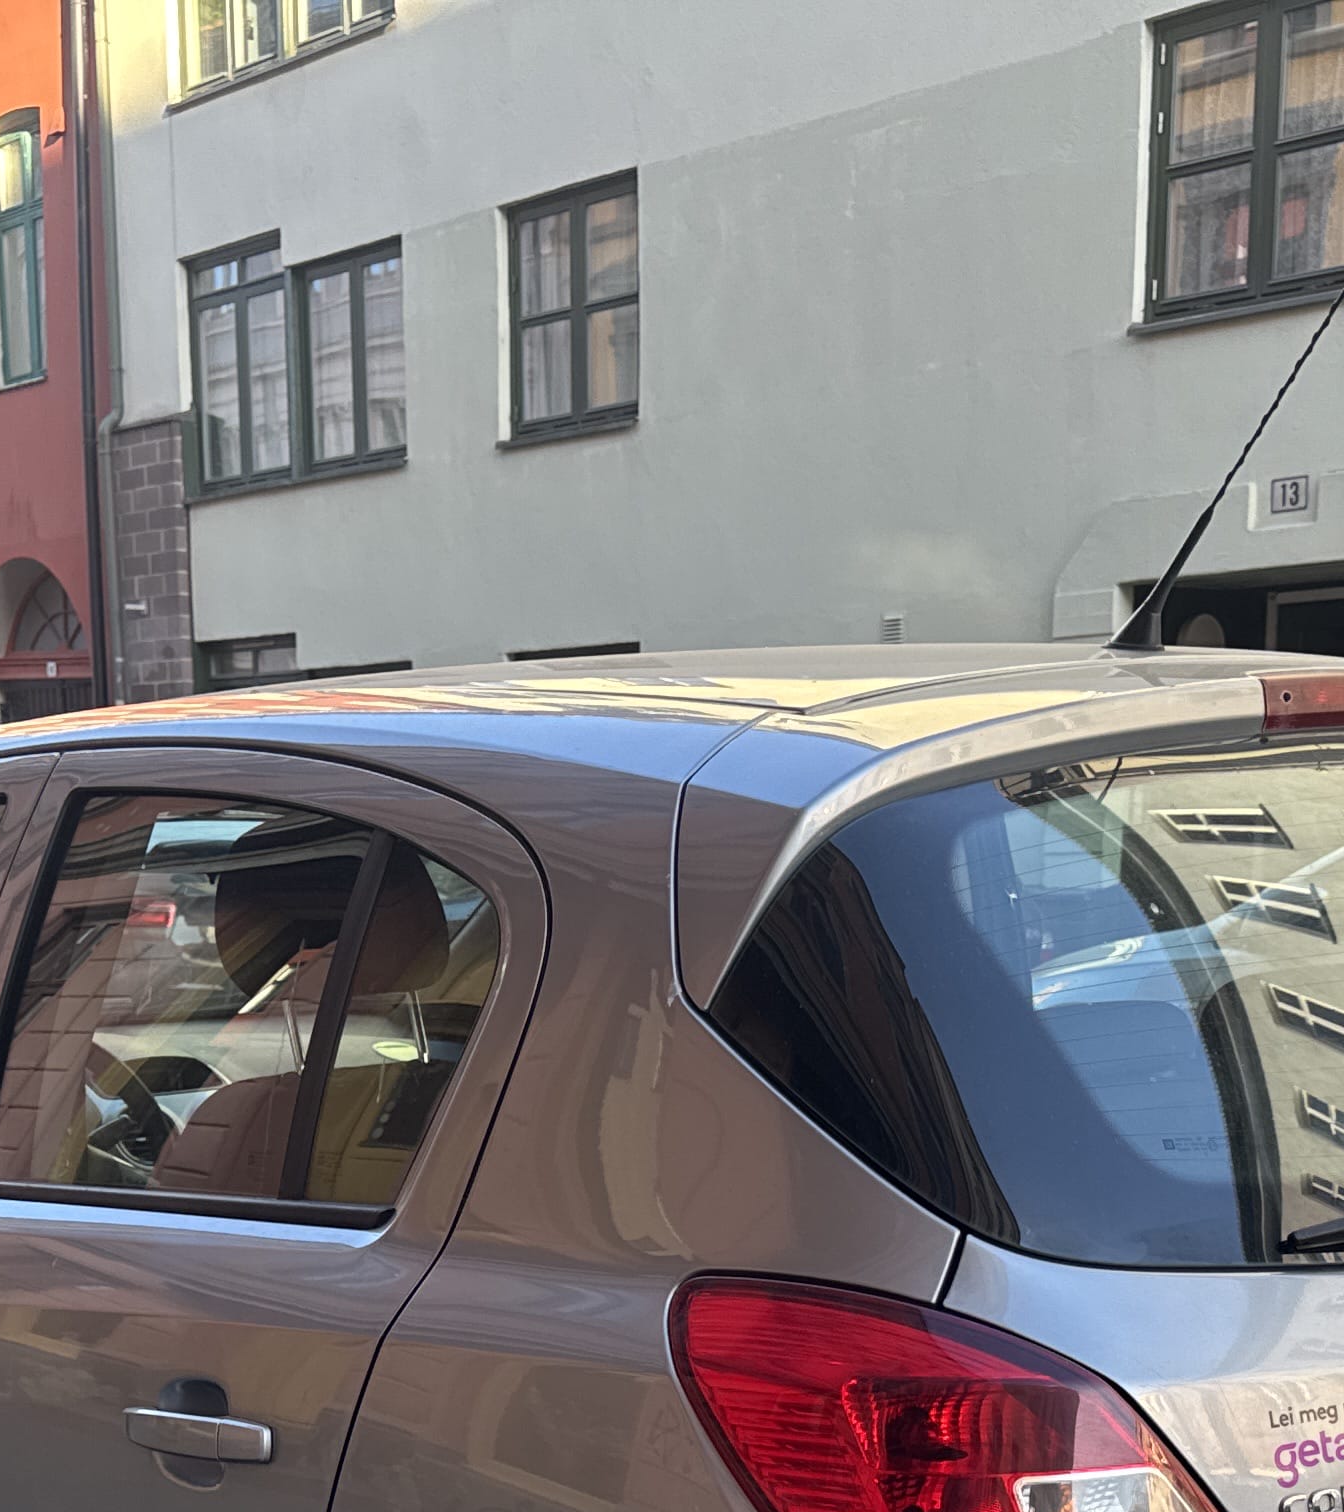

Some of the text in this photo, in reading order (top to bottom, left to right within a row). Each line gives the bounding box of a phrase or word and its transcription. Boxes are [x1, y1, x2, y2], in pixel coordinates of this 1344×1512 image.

[1280, 481, 1299, 507] 13
[1268, 1406, 1295, 1429] Lei
[1299, 1404, 1339, 1424] meg
